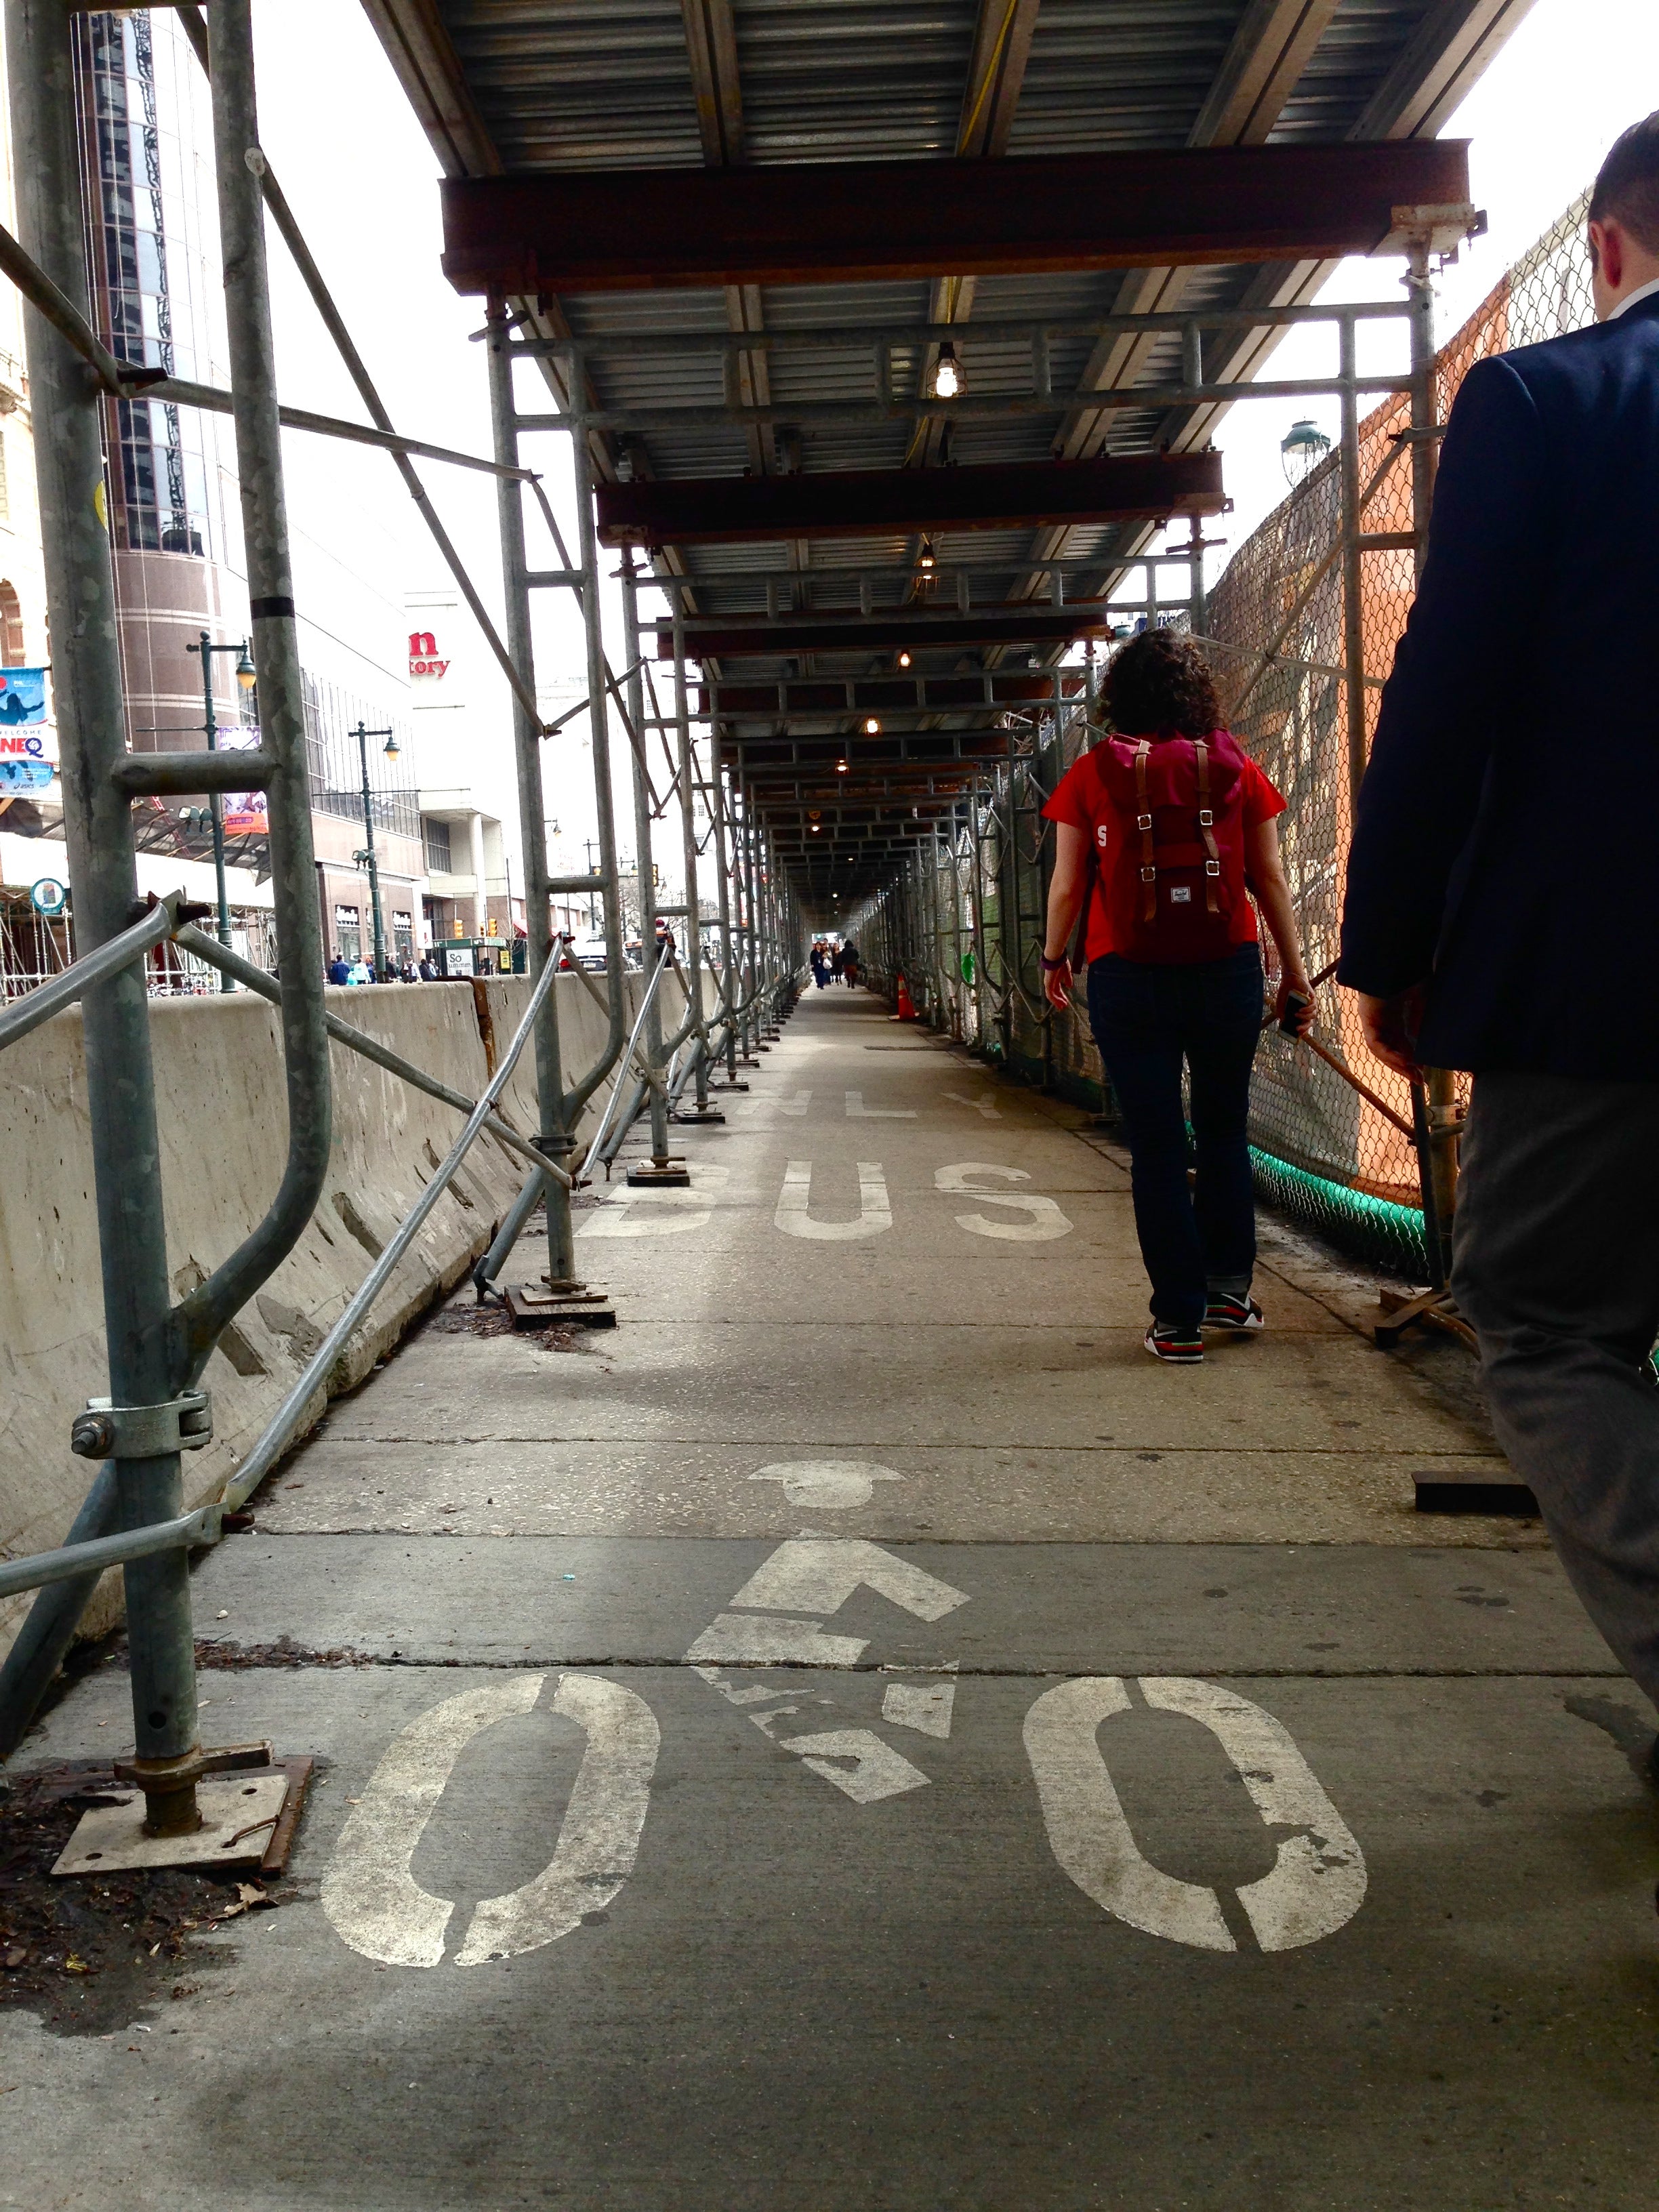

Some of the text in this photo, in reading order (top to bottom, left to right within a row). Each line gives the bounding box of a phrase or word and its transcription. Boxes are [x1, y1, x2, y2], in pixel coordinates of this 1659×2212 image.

[449, 954, 462, 963] So
[735, 1090, 1002, 1120] NLY
[572, 1160, 1075, 1241] BUS
